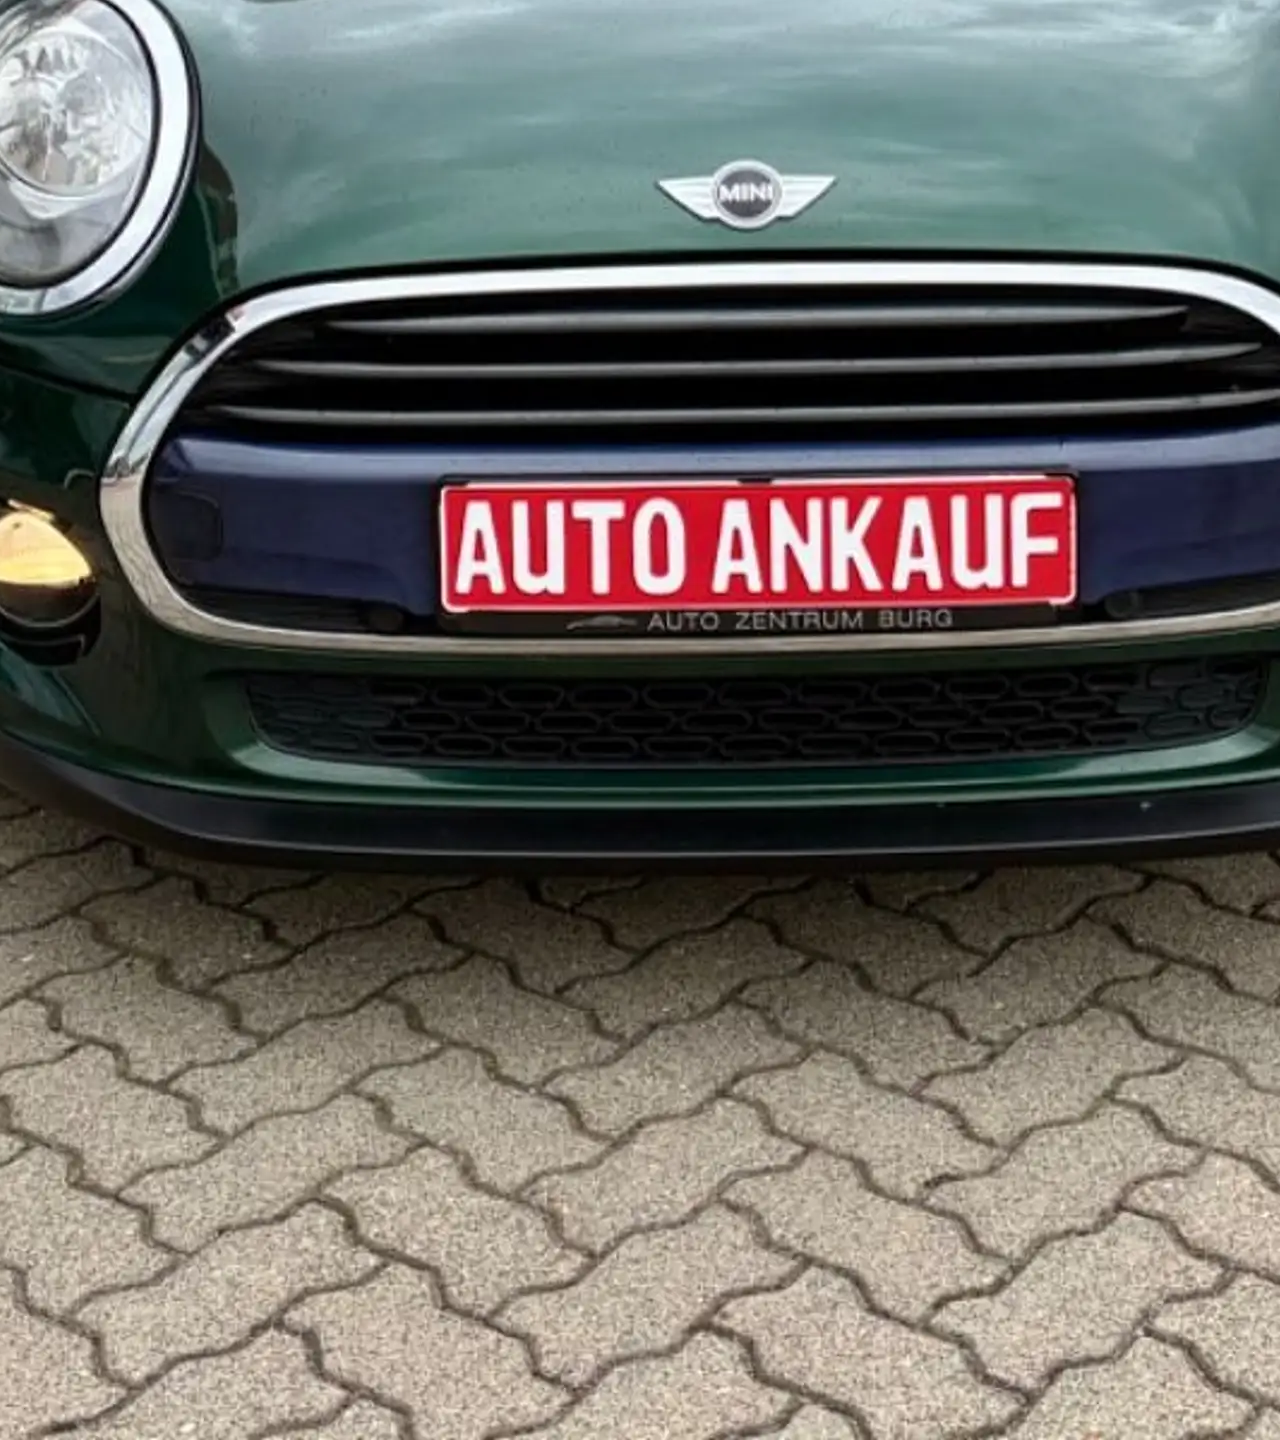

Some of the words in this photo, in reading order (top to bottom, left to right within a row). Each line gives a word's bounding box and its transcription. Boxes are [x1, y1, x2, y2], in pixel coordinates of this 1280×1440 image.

[720, 182, 774, 203] MINI
[455, 498, 686, 596] AUTO
[711, 492, 1063, 593] ANKAUF
[647, 612, 719, 632] AUTO
[735, 611, 864, 630] ZENTRUM
[878, 609, 953, 628] BURG
